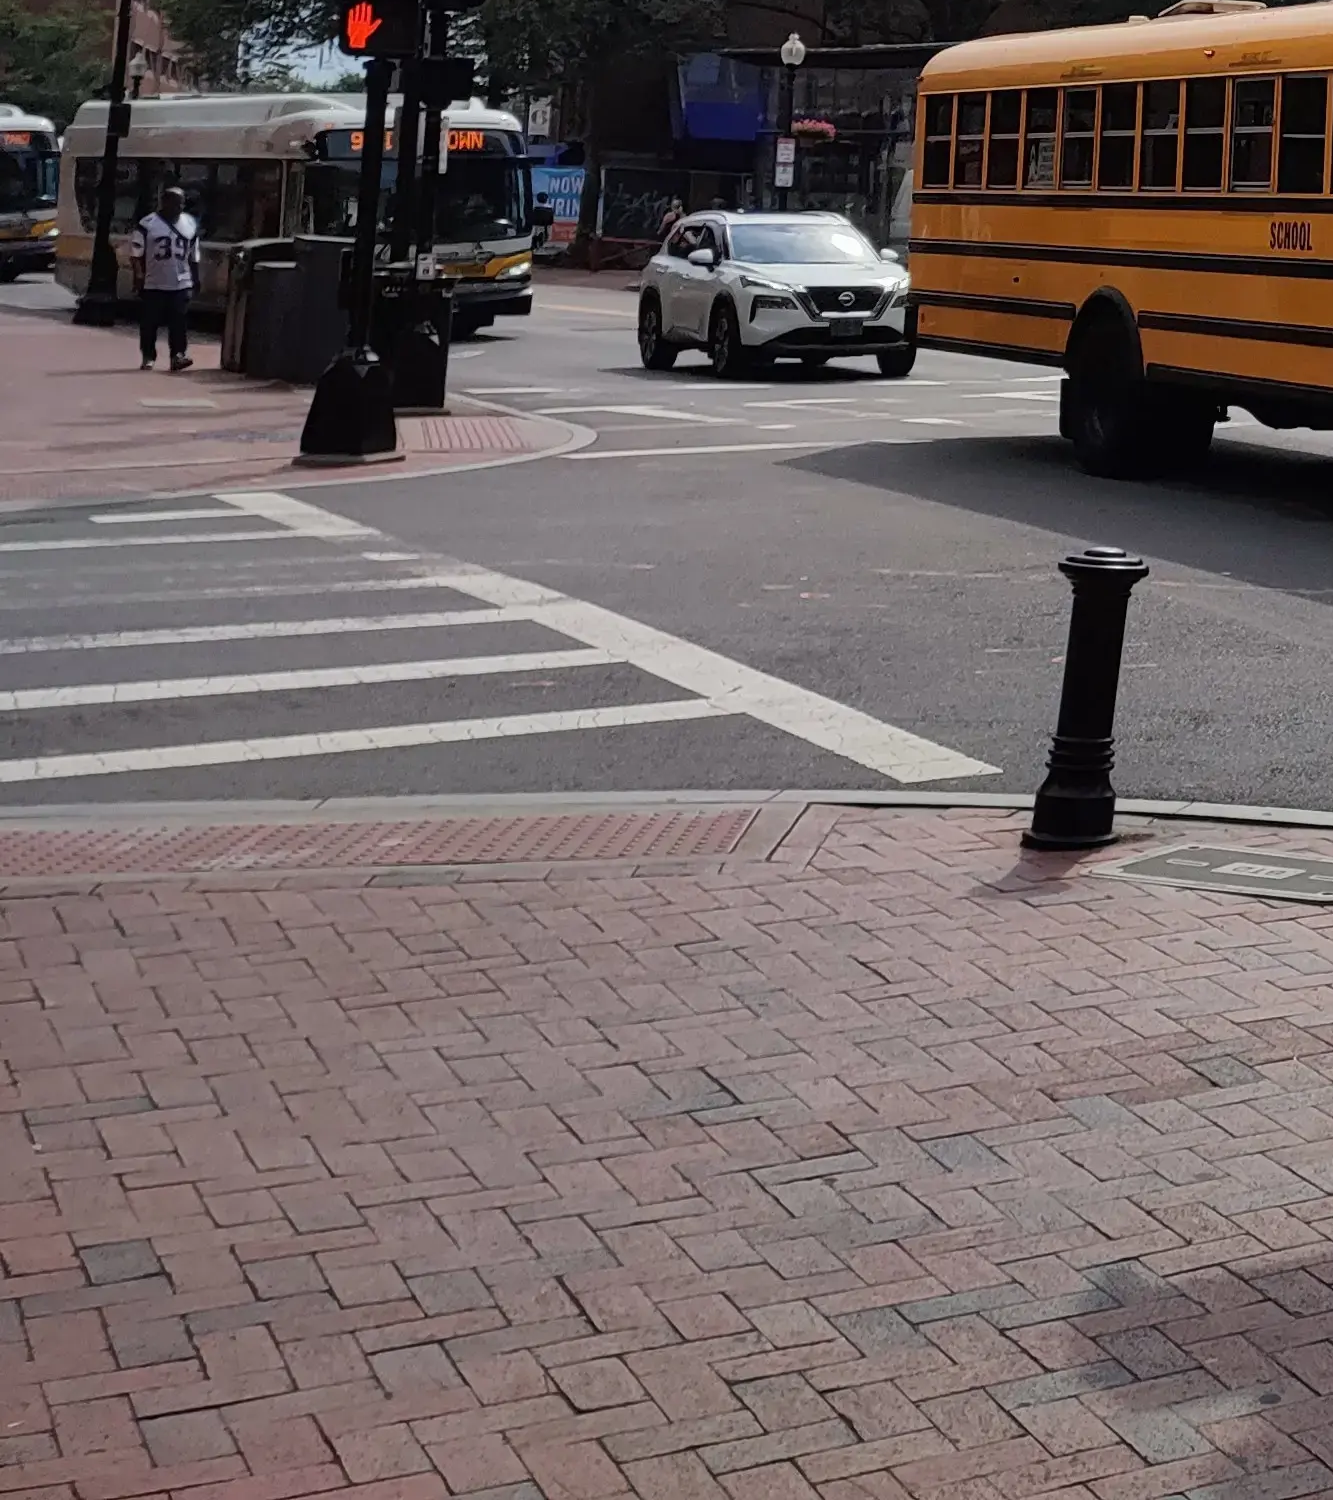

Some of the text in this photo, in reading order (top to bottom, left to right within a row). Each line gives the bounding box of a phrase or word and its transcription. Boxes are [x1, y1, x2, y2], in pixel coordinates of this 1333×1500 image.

[550, 177, 584, 194] NOW
[154, 236, 187, 260] 39
[1270, 222, 1312, 250] SCHOOL
